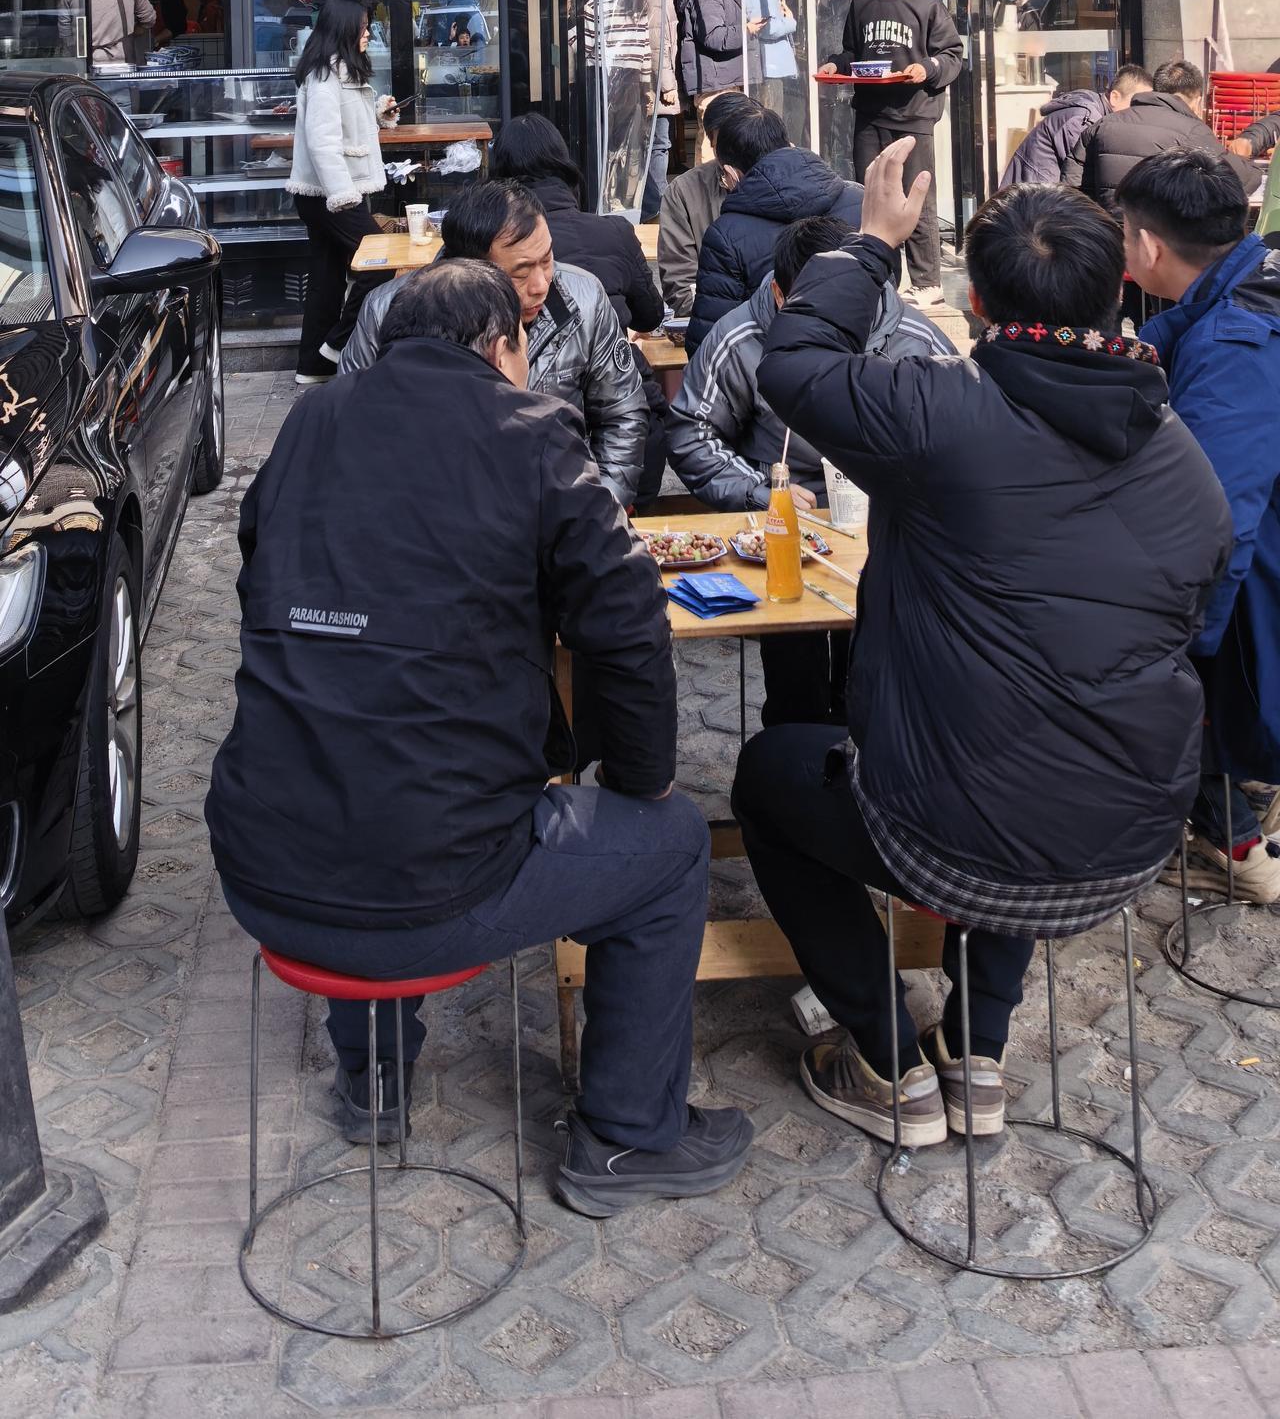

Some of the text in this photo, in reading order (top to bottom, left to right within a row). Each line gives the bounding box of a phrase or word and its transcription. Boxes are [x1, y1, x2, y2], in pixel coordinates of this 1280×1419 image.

[874, 19, 913, 49] ANGELES
[288, 607, 369, 628] PARAKA FASHION
